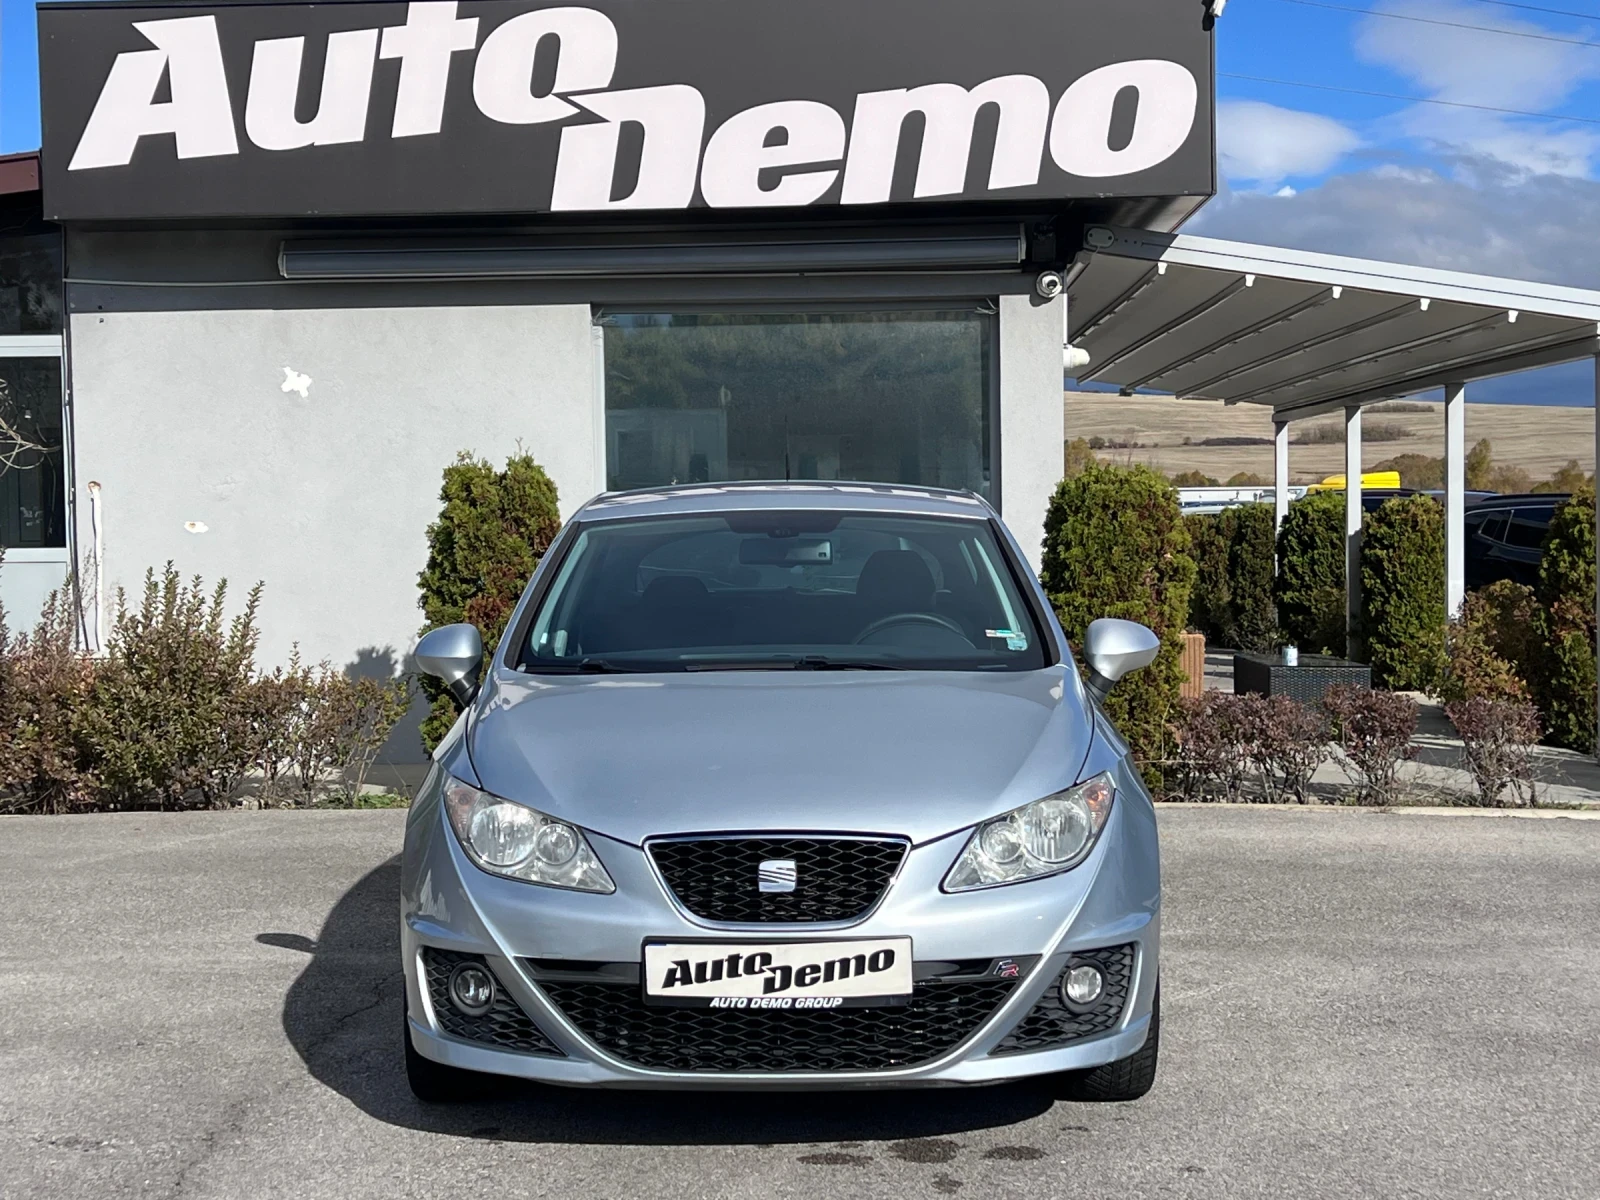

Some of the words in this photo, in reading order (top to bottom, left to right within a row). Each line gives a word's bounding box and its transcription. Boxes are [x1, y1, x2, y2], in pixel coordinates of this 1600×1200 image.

[67, 1, 618, 170] Auto
[551, 59, 1197, 211] Demo
[662, 952, 772, 989] Auto
[762, 949, 896, 995] Demo
[709, 997, 748, 1009] AUTO
[749, 997, 792, 1009] DEMO
[794, 997, 843, 1009] GROUP
